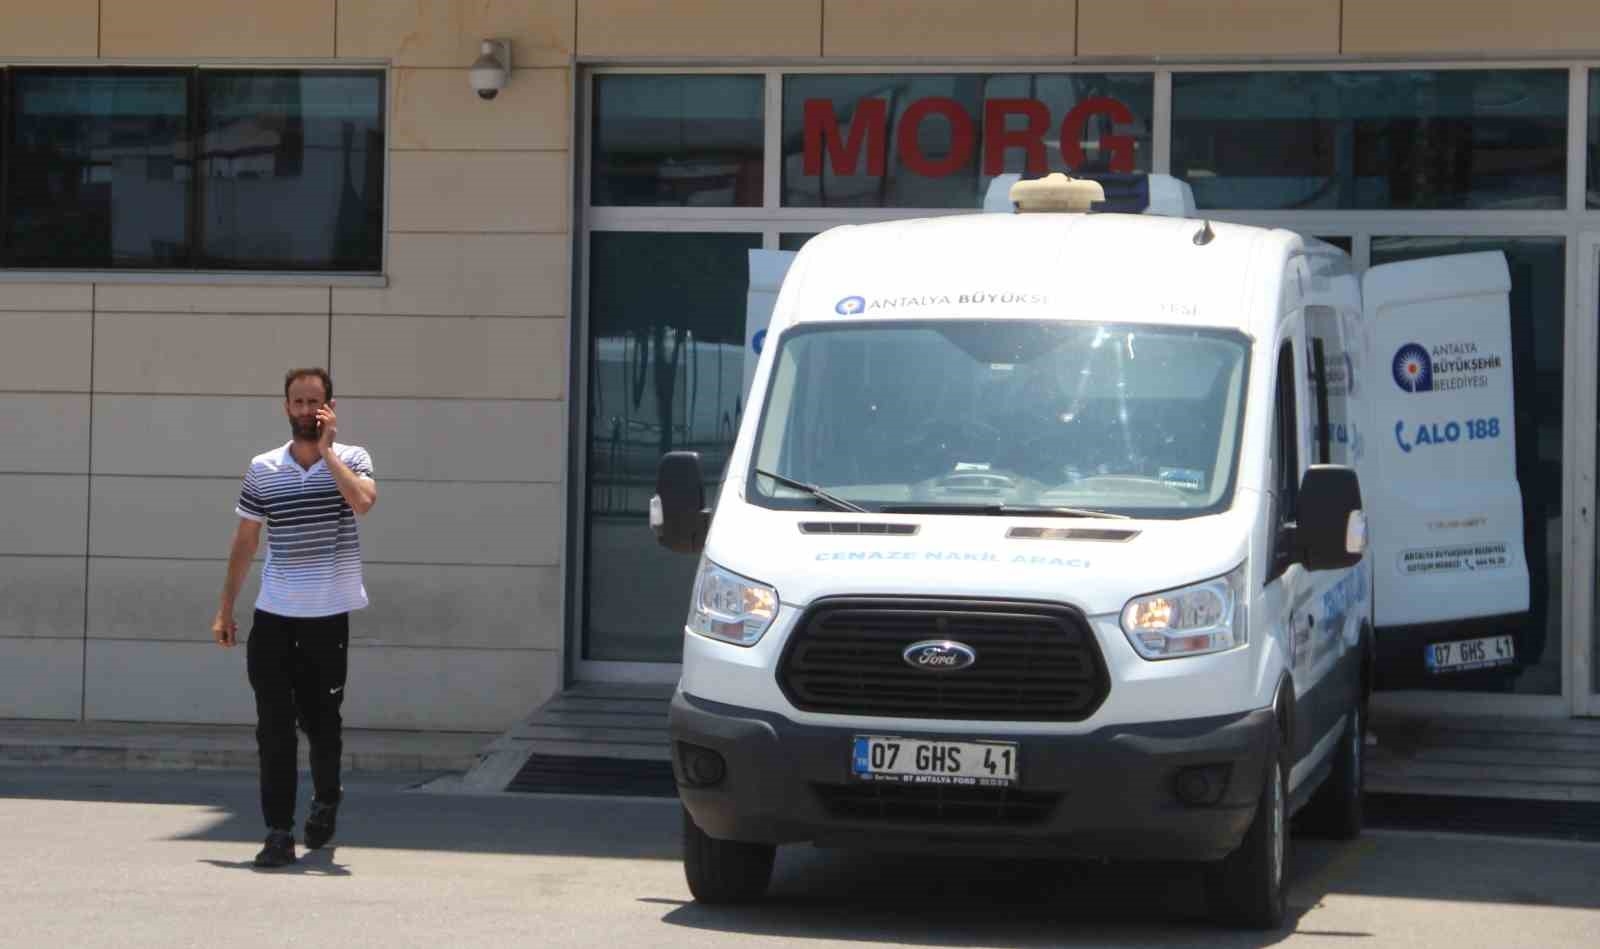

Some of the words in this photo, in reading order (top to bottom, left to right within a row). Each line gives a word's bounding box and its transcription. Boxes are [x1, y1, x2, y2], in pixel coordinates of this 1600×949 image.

[803, 96, 1137, 178] MORG
[868, 293, 950, 310] ANTALYA
[1432, 342, 1478, 356] ANTALYA
[1433, 353, 1502, 374] BÜYÜKŞEHİR
[1415, 421, 1460, 446] ALO
[1466, 417, 1500, 440] 188
[815, 551, 916, 562] CENAZE
[919, 646, 958, 665] Ford
[1435, 645, 1450, 665] 07
[1460, 640, 1486, 662] GHS
[1496, 638, 1511, 657] 41
[871, 742, 900, 769] 07
[915, 744, 961, 773] GHS
[984, 747, 1011, 775] 41
[915, 775, 951, 785] ANTALYA
[953, 776, 976, 785] FORD
